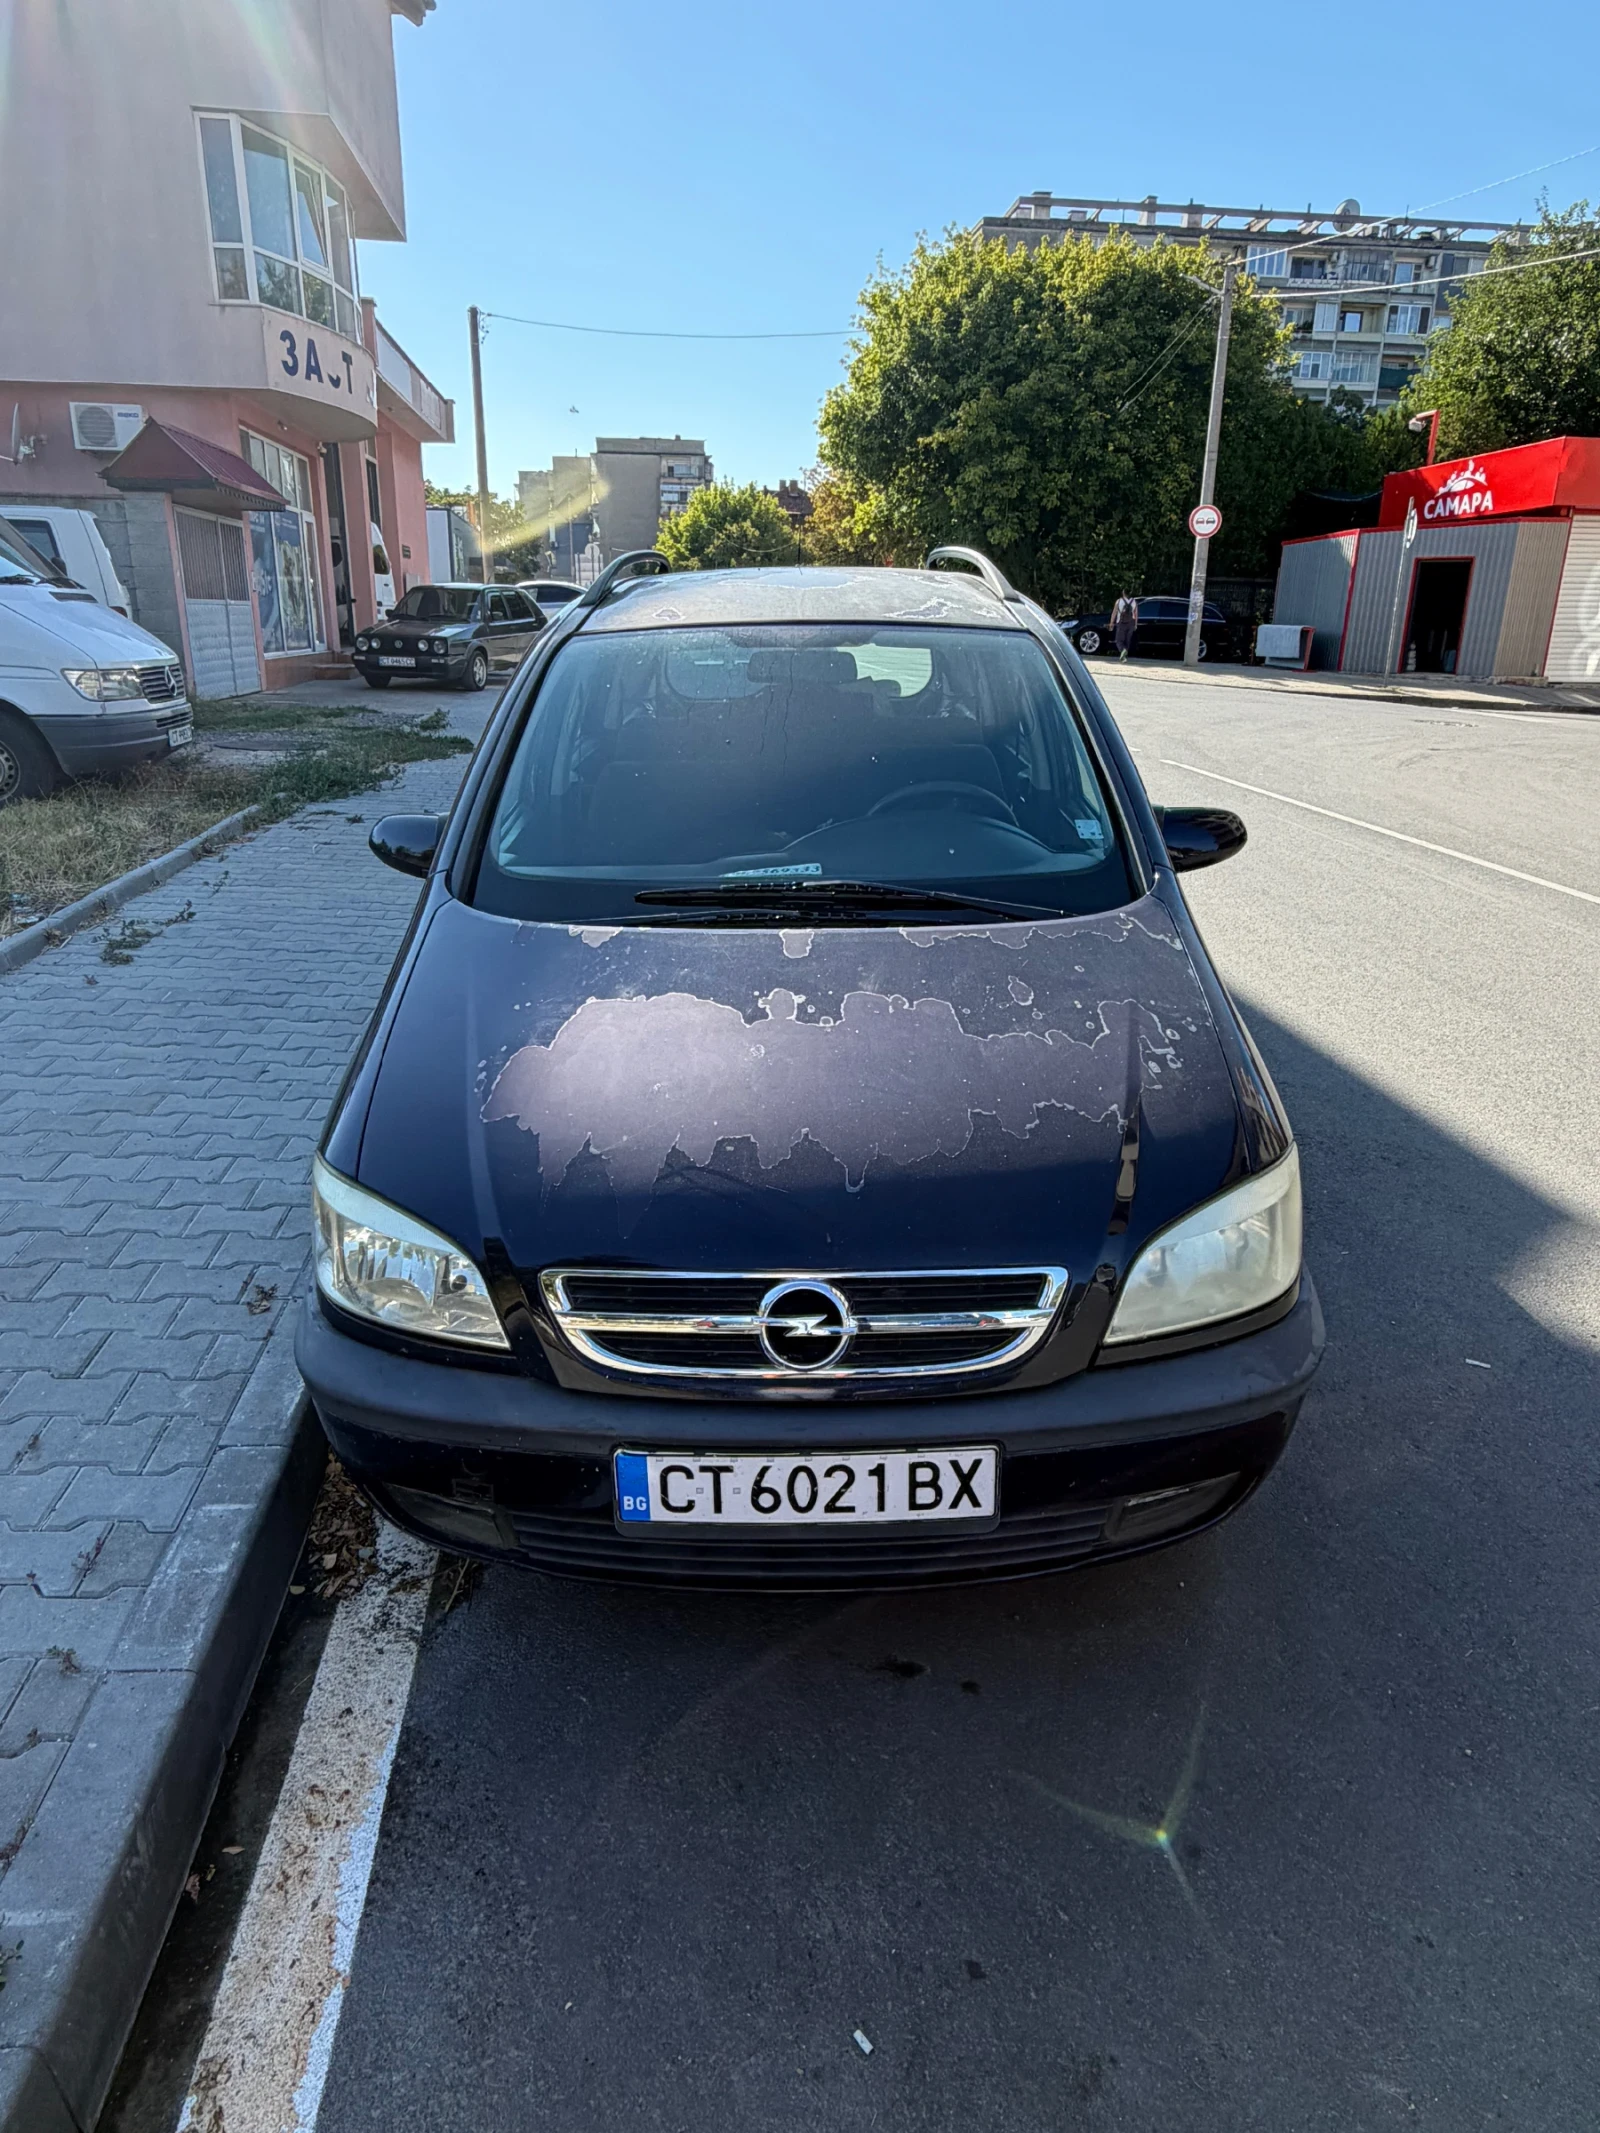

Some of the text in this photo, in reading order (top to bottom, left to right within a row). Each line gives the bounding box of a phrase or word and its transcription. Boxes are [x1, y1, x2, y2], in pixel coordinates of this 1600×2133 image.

[1424, 490, 1493, 519] САМАРА
[659, 1457, 984, 1514] CT 6021 BX
[622, 1495, 648, 1512] BG
